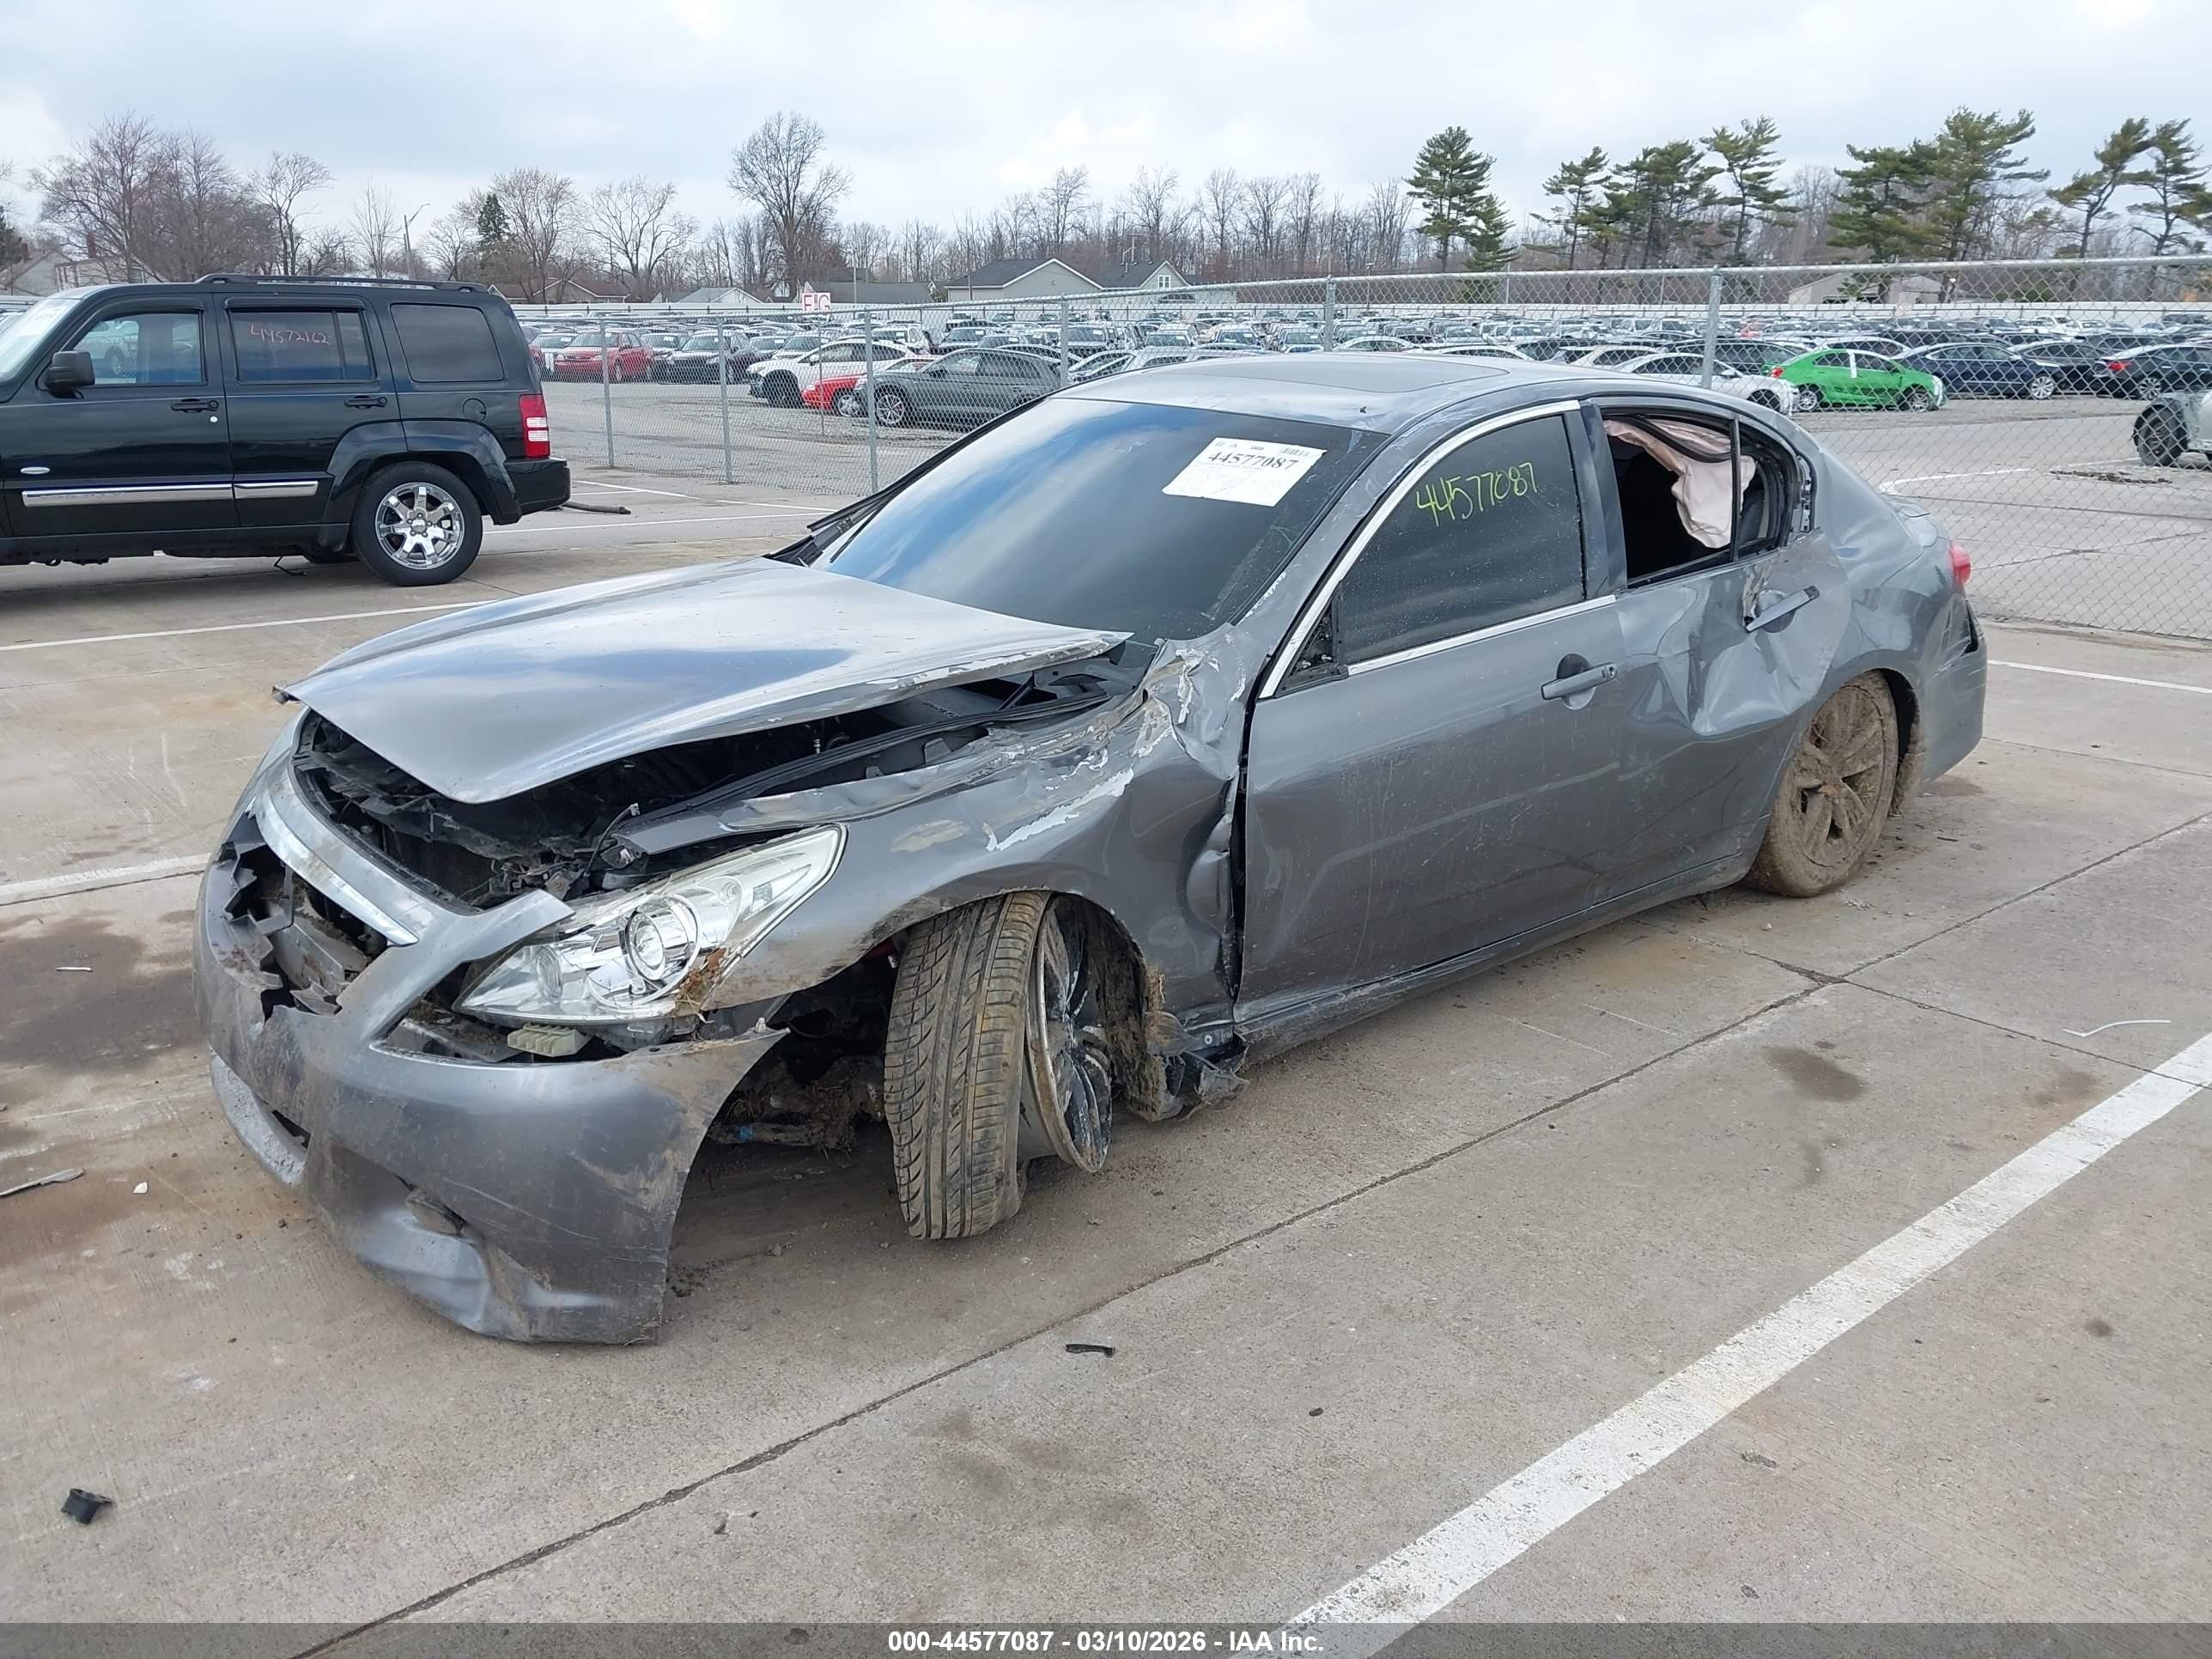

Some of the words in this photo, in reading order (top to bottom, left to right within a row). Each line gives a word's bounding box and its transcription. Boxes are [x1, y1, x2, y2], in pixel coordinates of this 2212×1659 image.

[250, 324, 331, 345] 44572162
[1208, 451, 1300, 471] 44577087
[1416, 462, 1538, 527] 44577087
